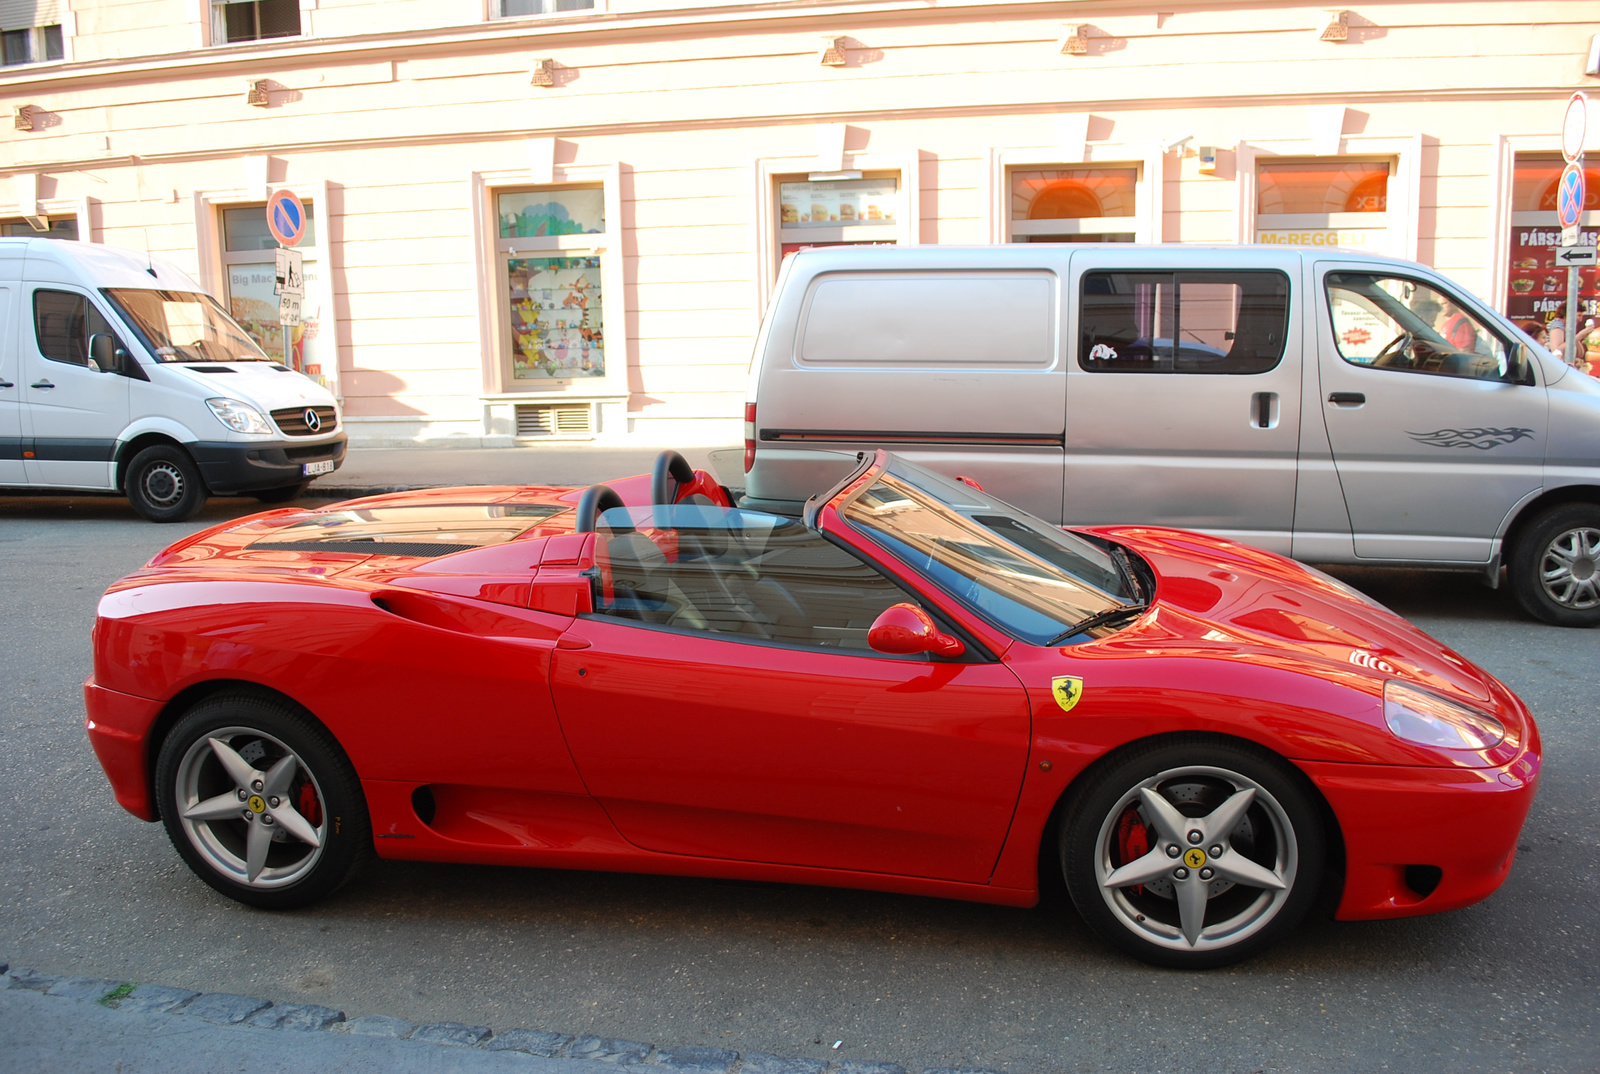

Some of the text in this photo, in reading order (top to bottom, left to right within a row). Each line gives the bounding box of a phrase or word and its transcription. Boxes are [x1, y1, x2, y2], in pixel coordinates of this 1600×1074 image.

[232, 274, 249, 286] Big
[281, 298, 300, 310] 50 m
